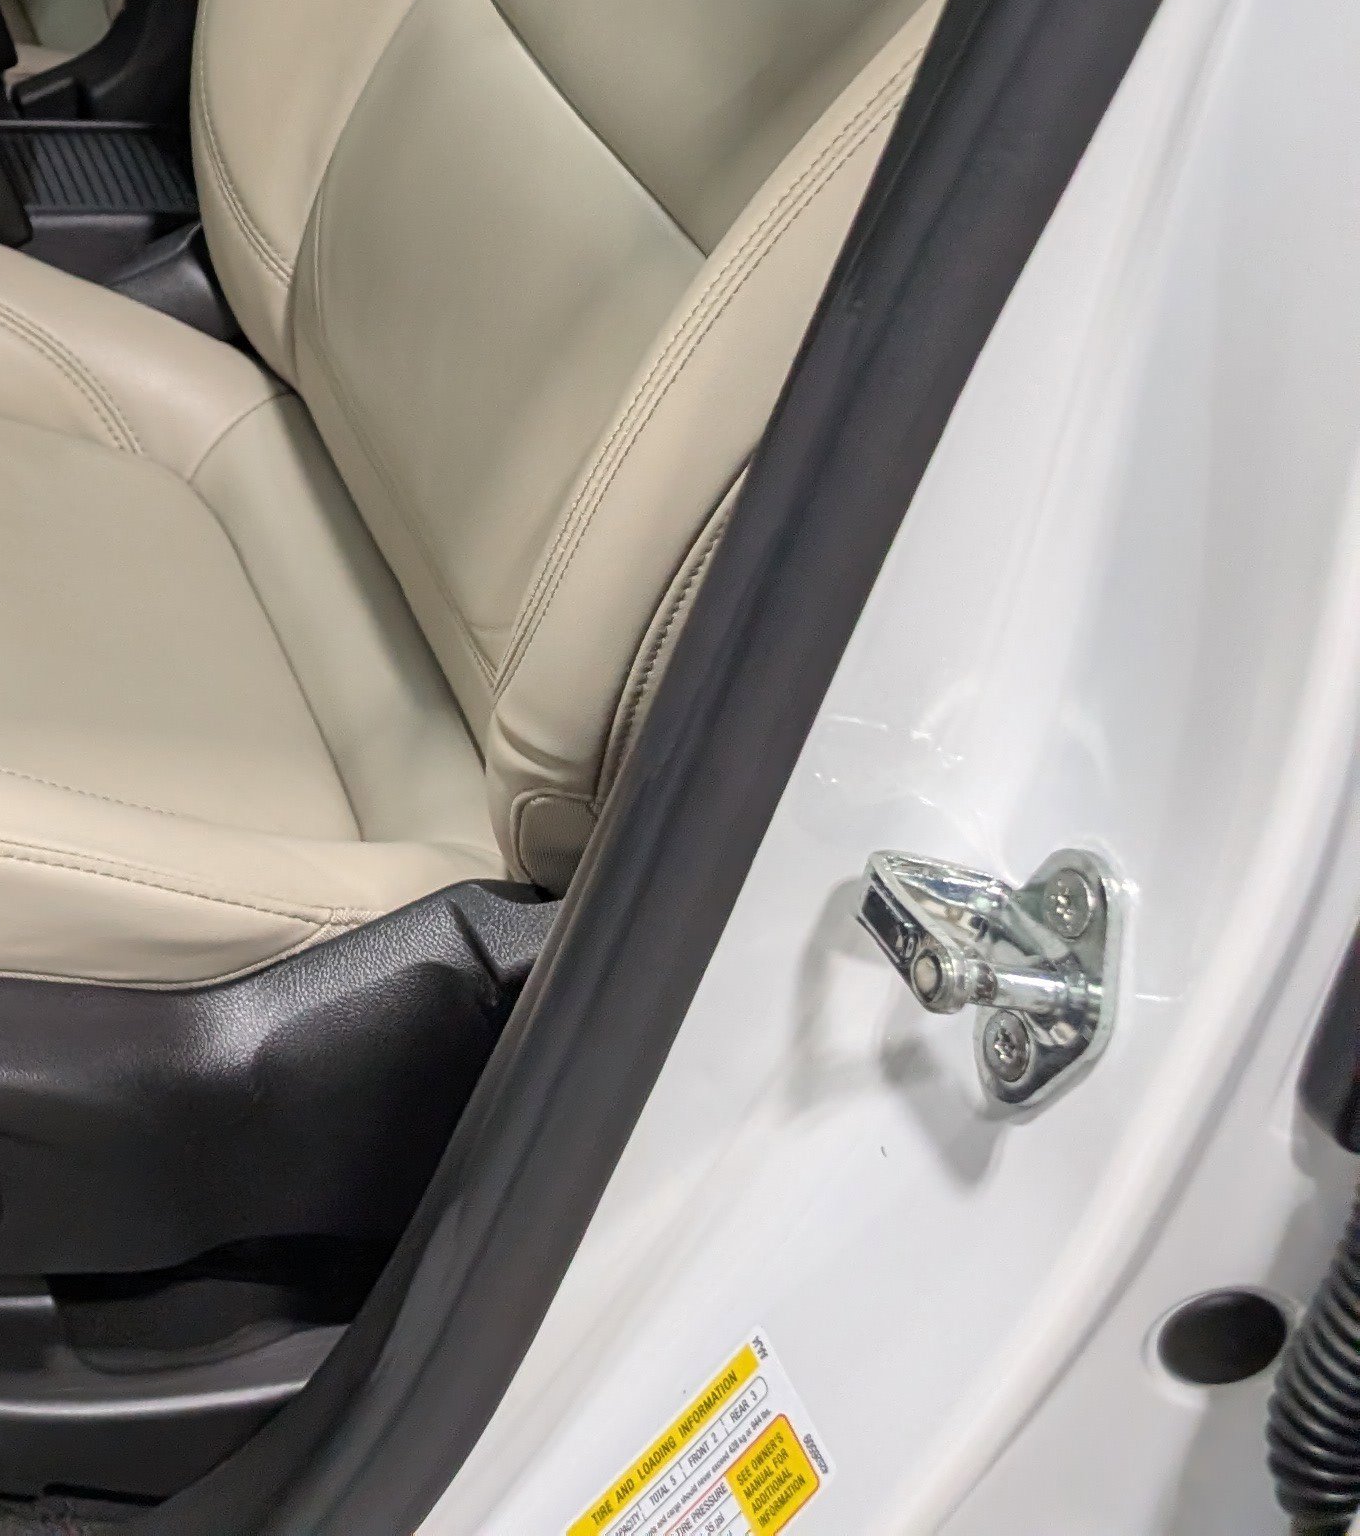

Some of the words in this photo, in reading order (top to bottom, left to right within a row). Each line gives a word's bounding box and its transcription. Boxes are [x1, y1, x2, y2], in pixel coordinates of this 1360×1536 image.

[591, 1500, 613, 1526] TIRE
[615, 1479, 635, 1503] AND
[637, 1436, 677, 1480] LOADING
[678, 1370, 738, 1438] INFORMATION
[649, 1484, 670, 1506] TOTAL
[688, 1441, 710, 1468] FRONT
[711, 1432, 719, 1444] 2
[729, 1399, 750, 1423] REAR
[750, 1390, 758, 1401] 3
[737, 1465, 752, 1486] SEE
[751, 1432, 784, 1471] OWNER'S
[743, 1465, 774, 1500] MANUAL
[772, 1447, 789, 1469] FOR
[691, 1482, 728, 1523] PRESSURE
[751, 1467, 793, 1514] ADDITIONAL
[757, 1473, 806, 1528] INFORMATION
